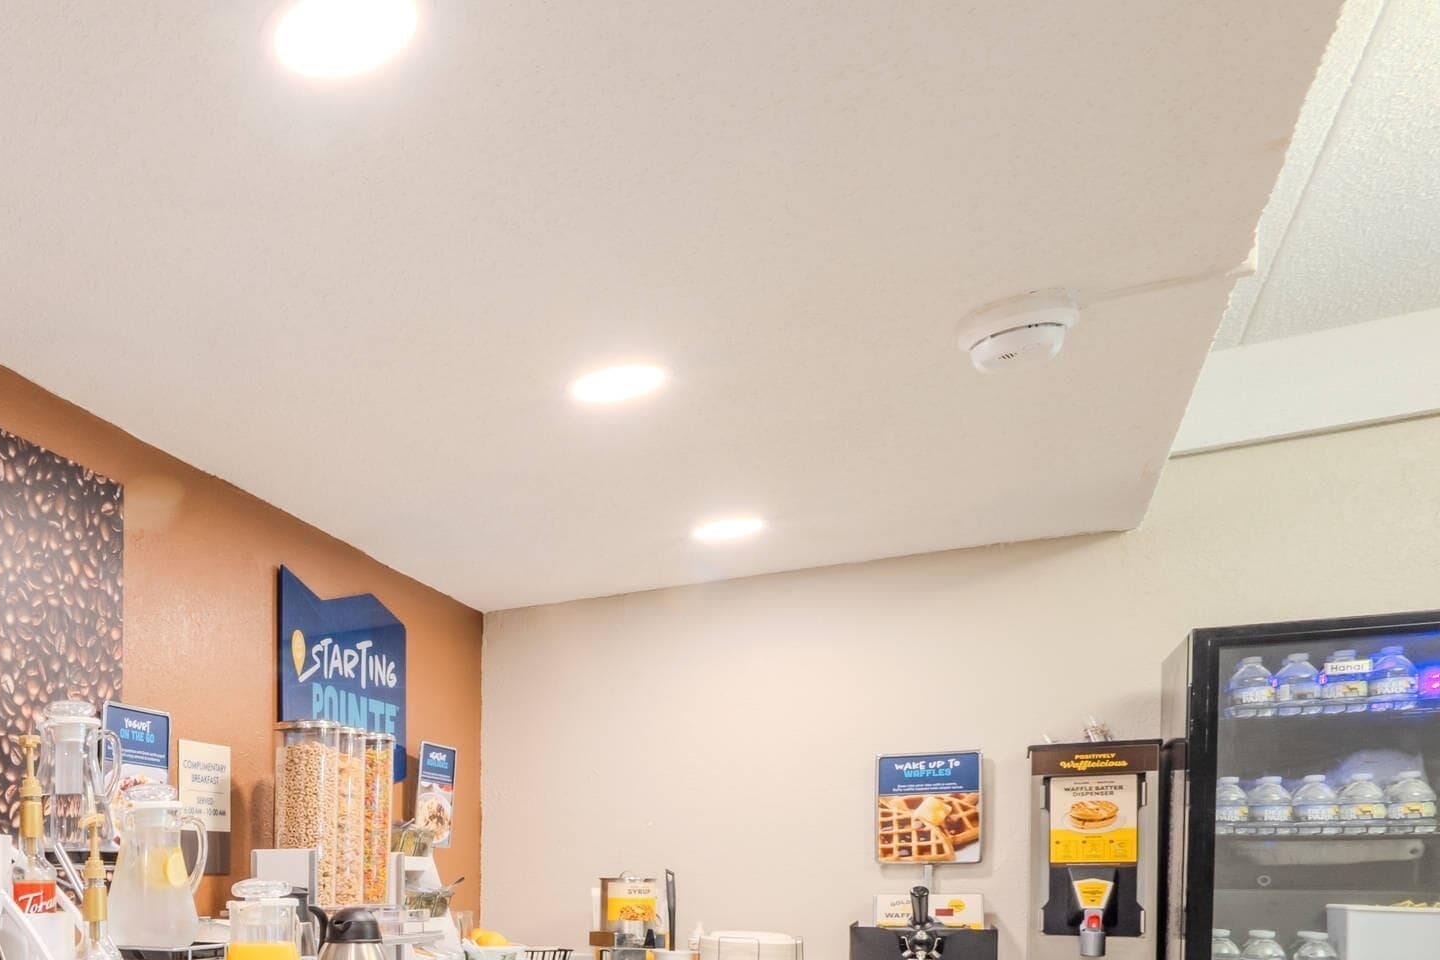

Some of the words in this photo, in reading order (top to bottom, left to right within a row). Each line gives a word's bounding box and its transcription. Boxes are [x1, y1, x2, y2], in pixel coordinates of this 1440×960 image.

[298, 638, 397, 689] STARTING
[312, 682, 397, 734] POINTE
[124, 717, 152, 733] YOGURT
[120, 728, 130, 740] ON
[131, 730, 145, 742] THE
[894, 761, 926, 771] WAKE
[928, 760, 945, 769] UP
[191, 773, 219, 785] BREAKFAST
[904, 768, 952, 778] WAFFLES
